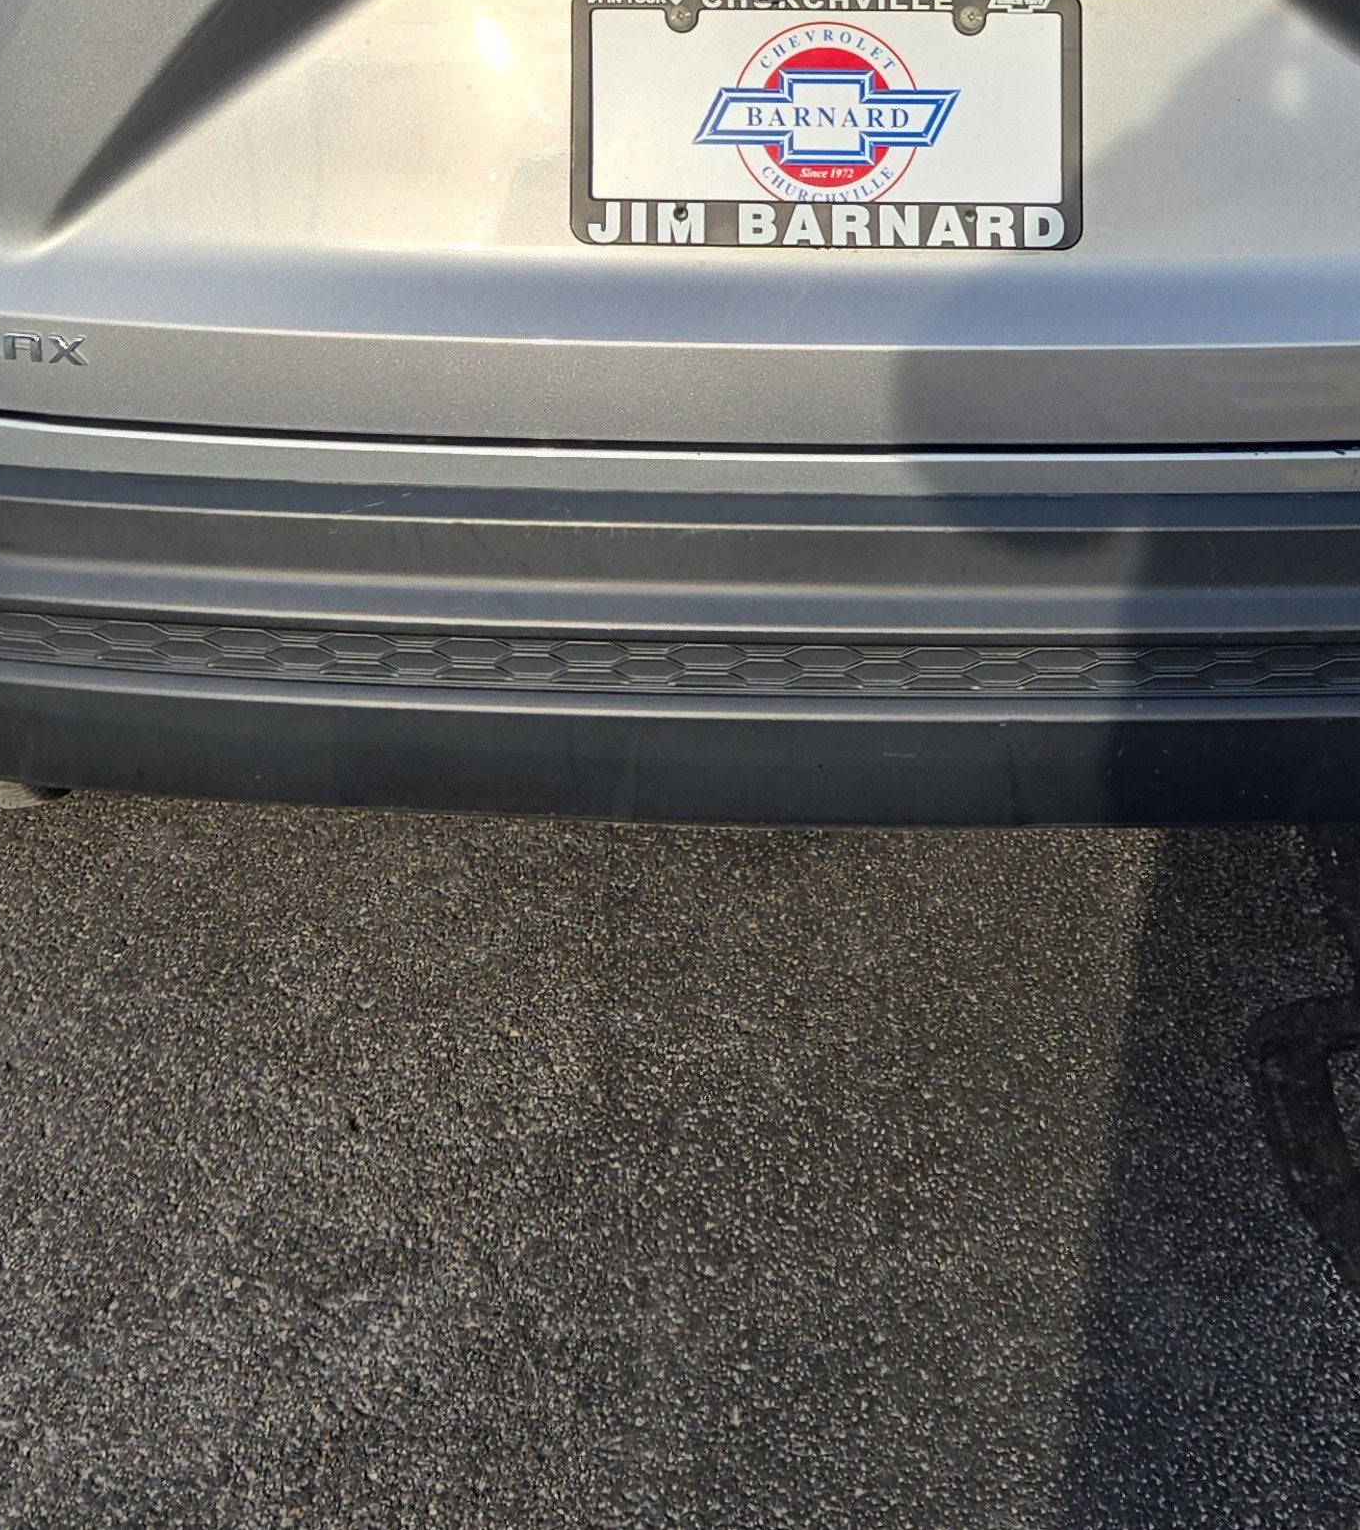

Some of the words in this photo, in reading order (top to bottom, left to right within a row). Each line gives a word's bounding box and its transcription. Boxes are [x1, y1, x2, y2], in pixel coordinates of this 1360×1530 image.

[760, 29, 896, 70] CHEVROLET
[746, 106, 909, 128] BARNARD
[799, 167, 828, 179] Since
[830, 167, 855, 179] 1972
[588, 202, 706, 245] JIM
[738, 202, 1066, 248] BARNARD
